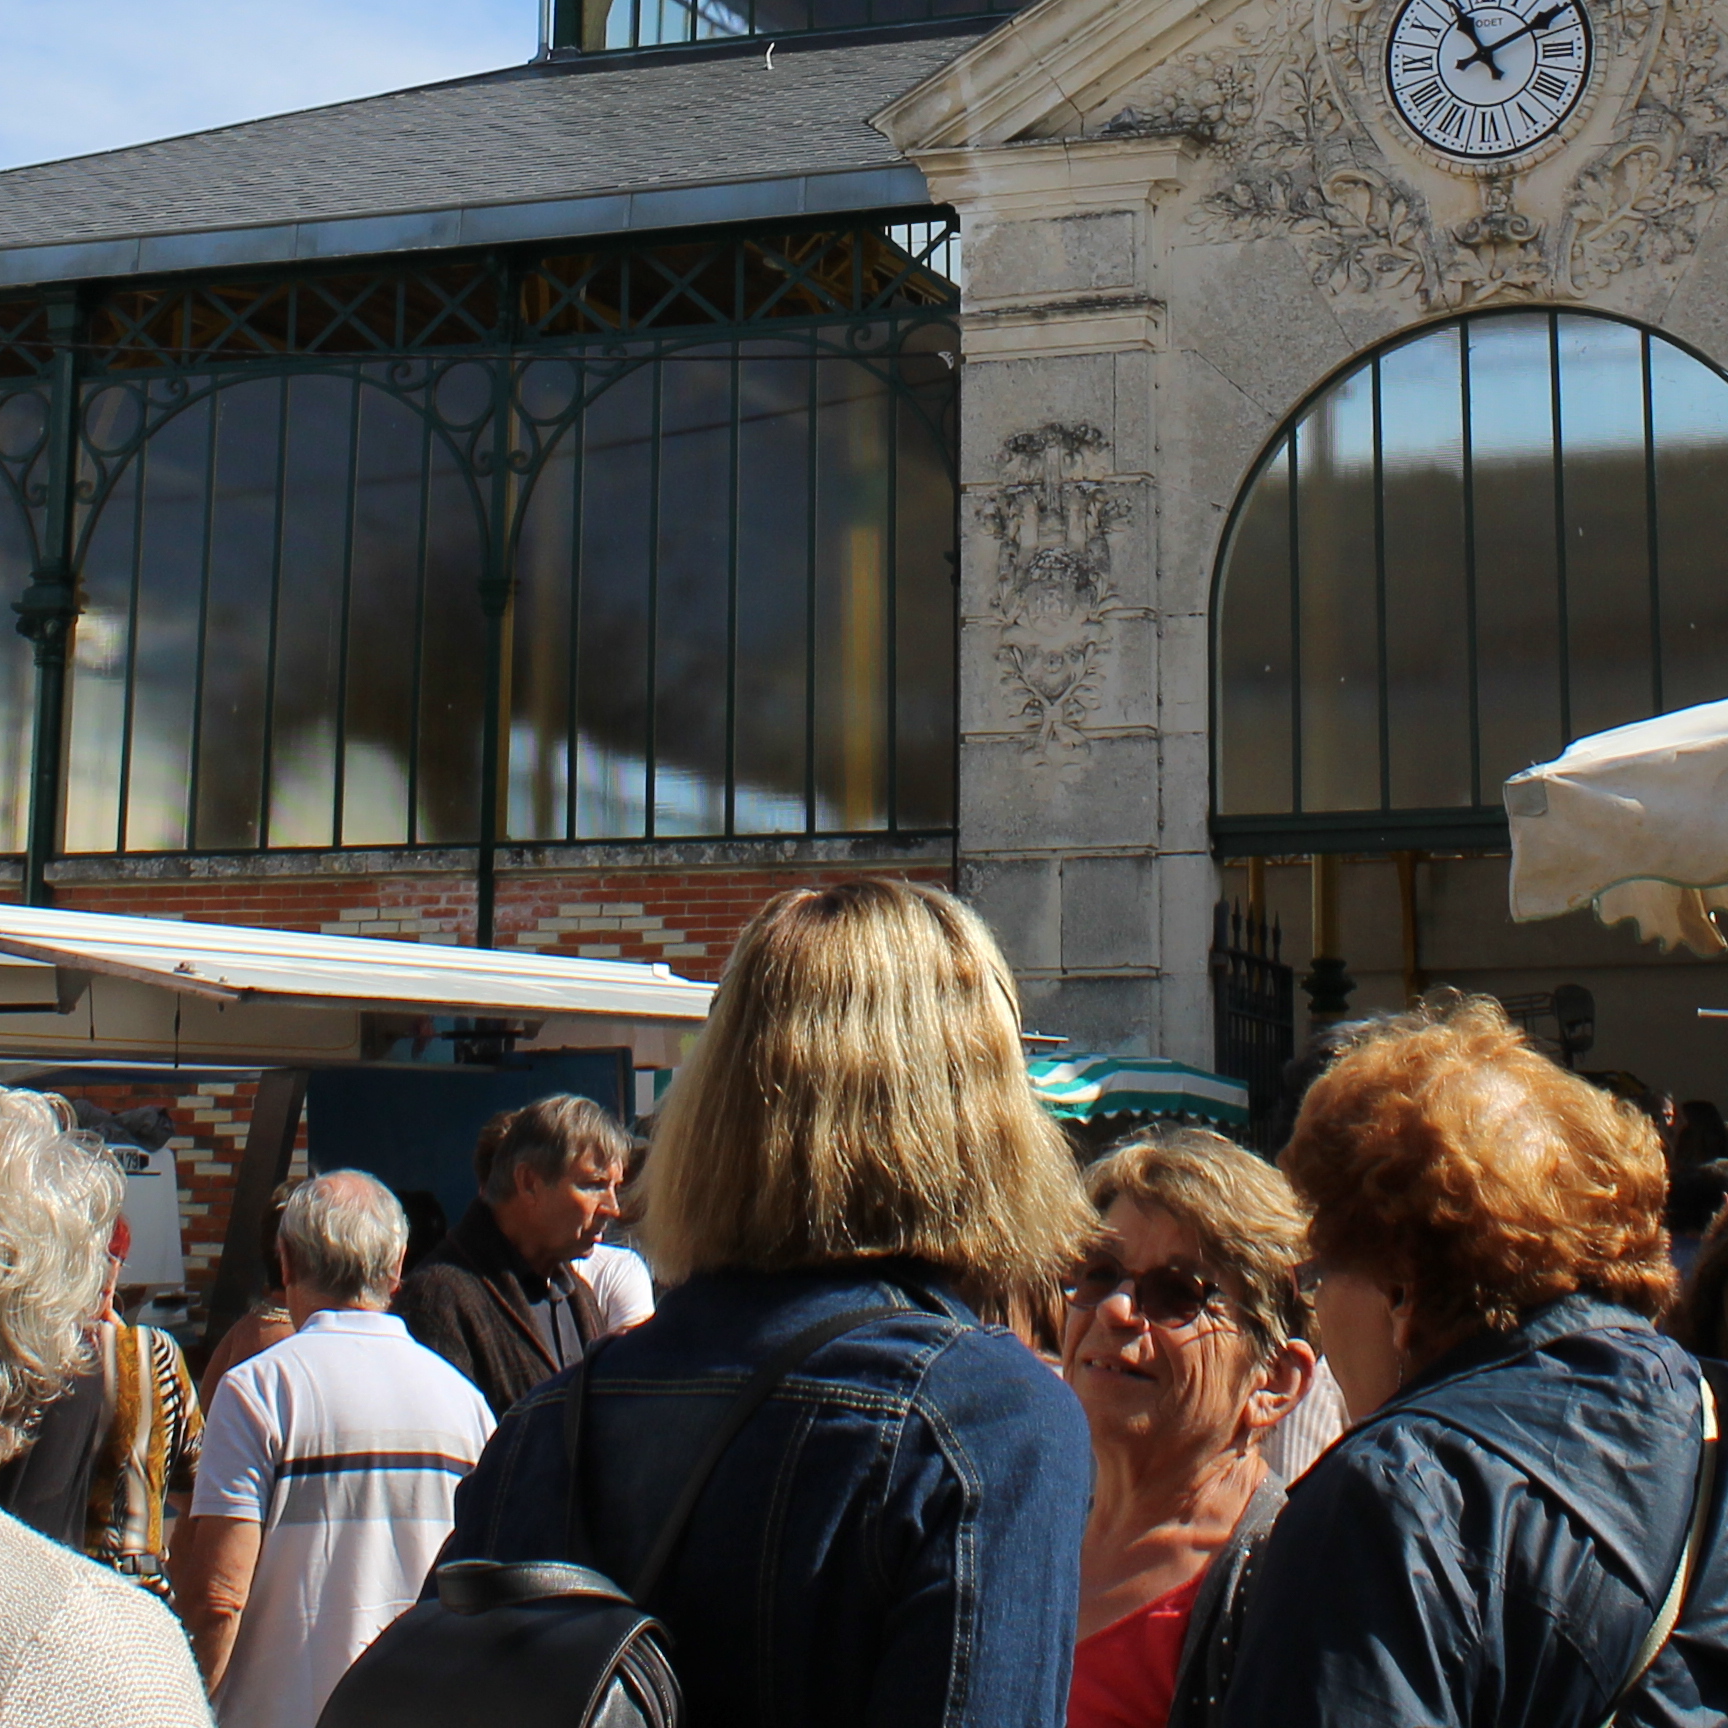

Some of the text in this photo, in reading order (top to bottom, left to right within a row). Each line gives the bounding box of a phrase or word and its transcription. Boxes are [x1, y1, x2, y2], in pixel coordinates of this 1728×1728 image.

[1411, 17, 1441, 39] X
[1476, 17, 1503, 28] ODET
[1542, 41, 1574, 59] III
[1480, 111, 1500, 142] VI
